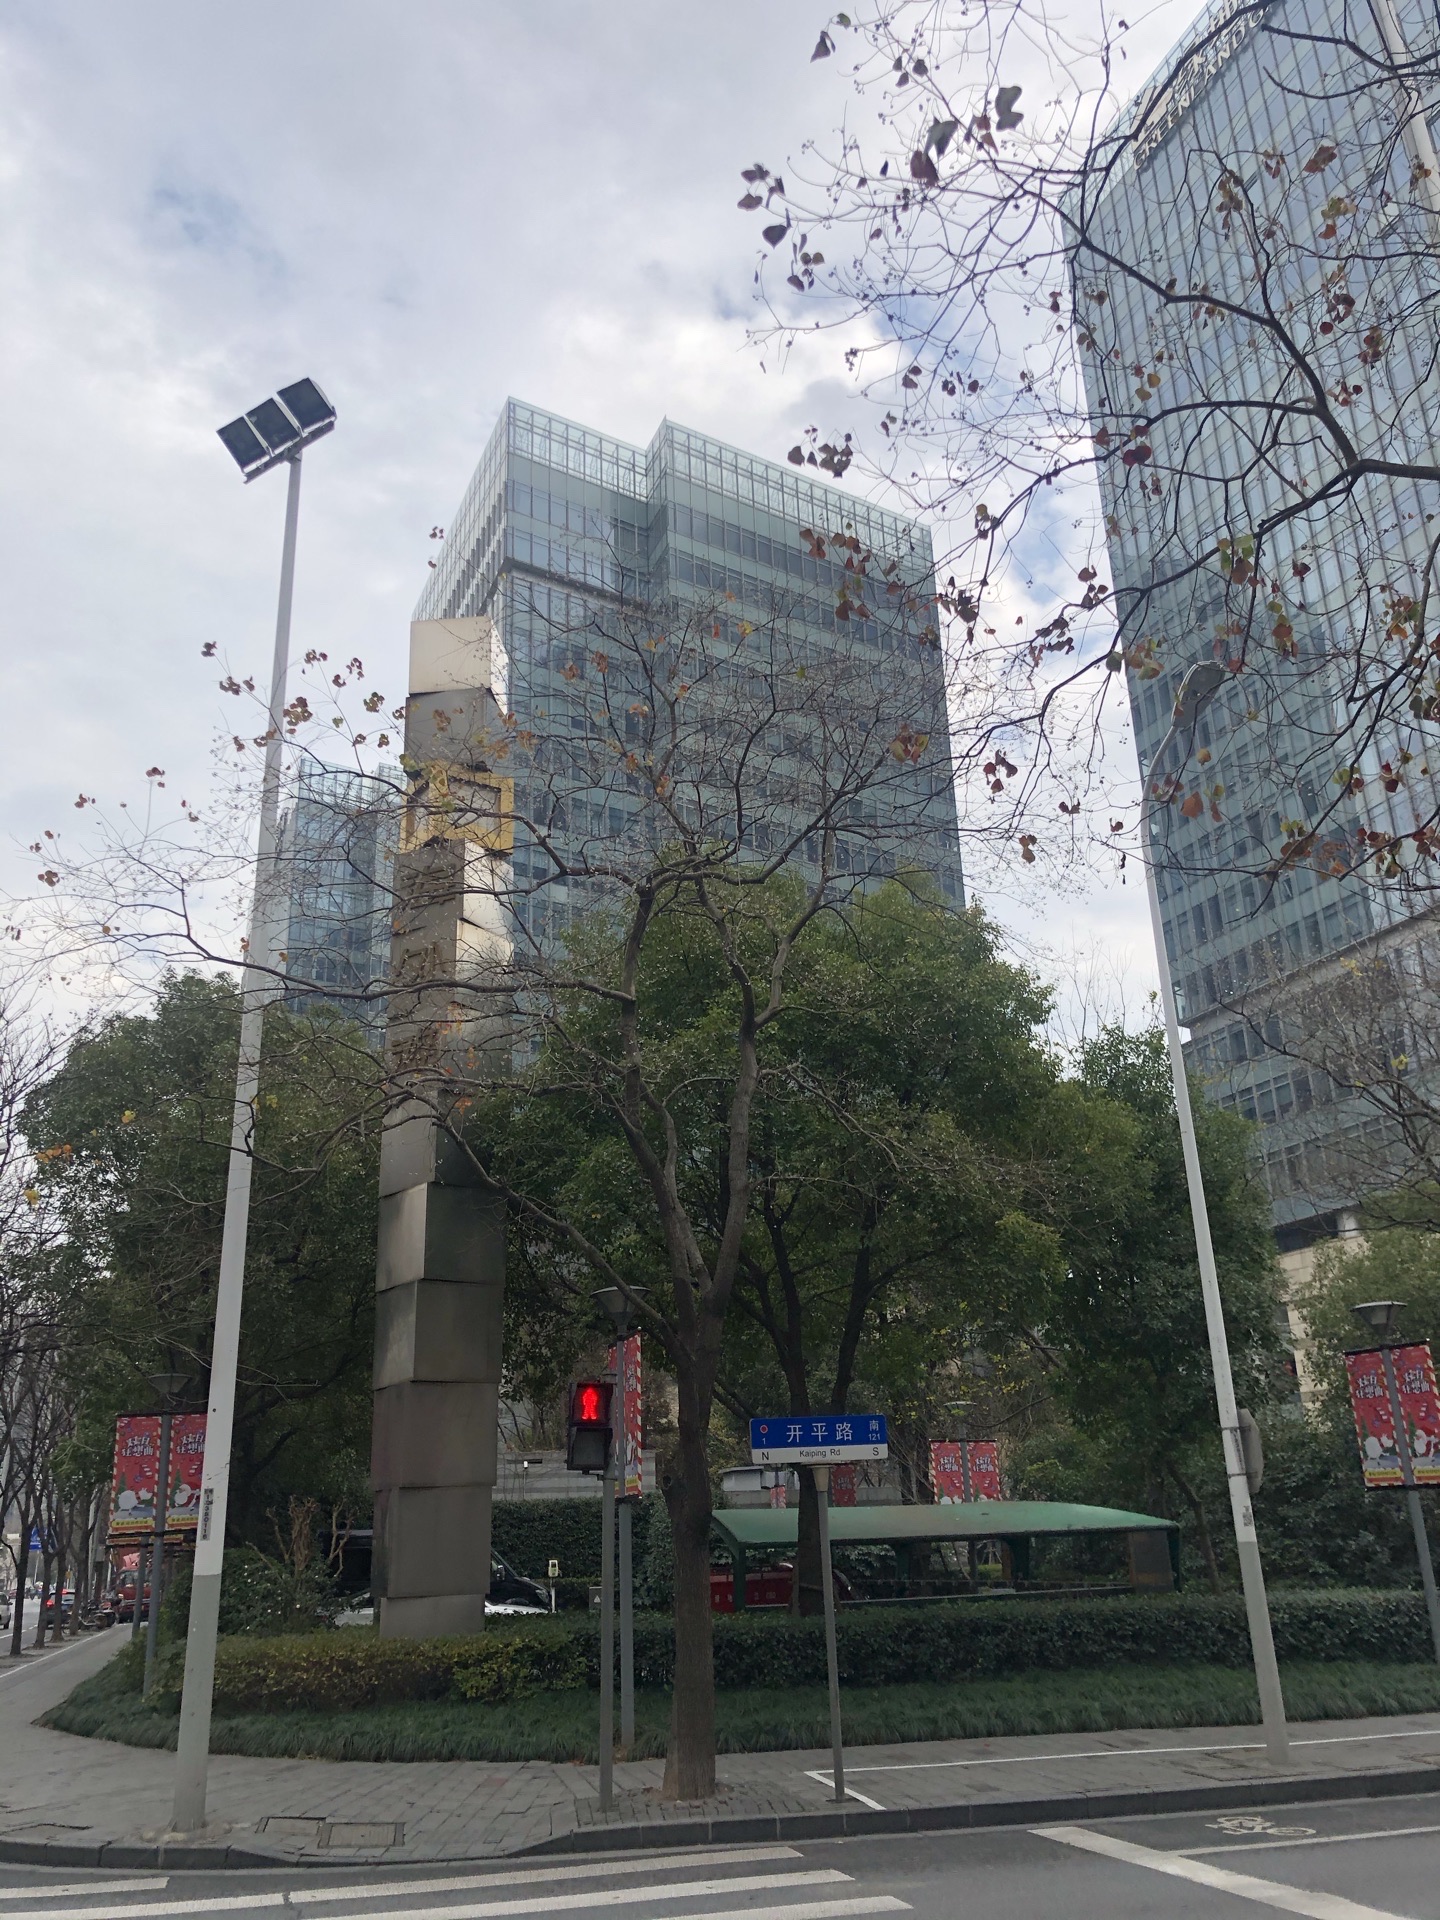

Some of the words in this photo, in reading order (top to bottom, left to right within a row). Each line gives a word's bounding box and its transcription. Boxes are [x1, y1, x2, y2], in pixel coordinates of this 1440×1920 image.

[868, 1419, 880, 1432] 南
[786, 1421, 853, 1443] 开平路
[868, 1433, 881, 1441] 121
[761, 1451, 770, 1461] N
[799, 1449, 827, 1459] Kaiping
[830, 1448, 841, 1456] Rd
[872, 1447, 879, 1456] S
